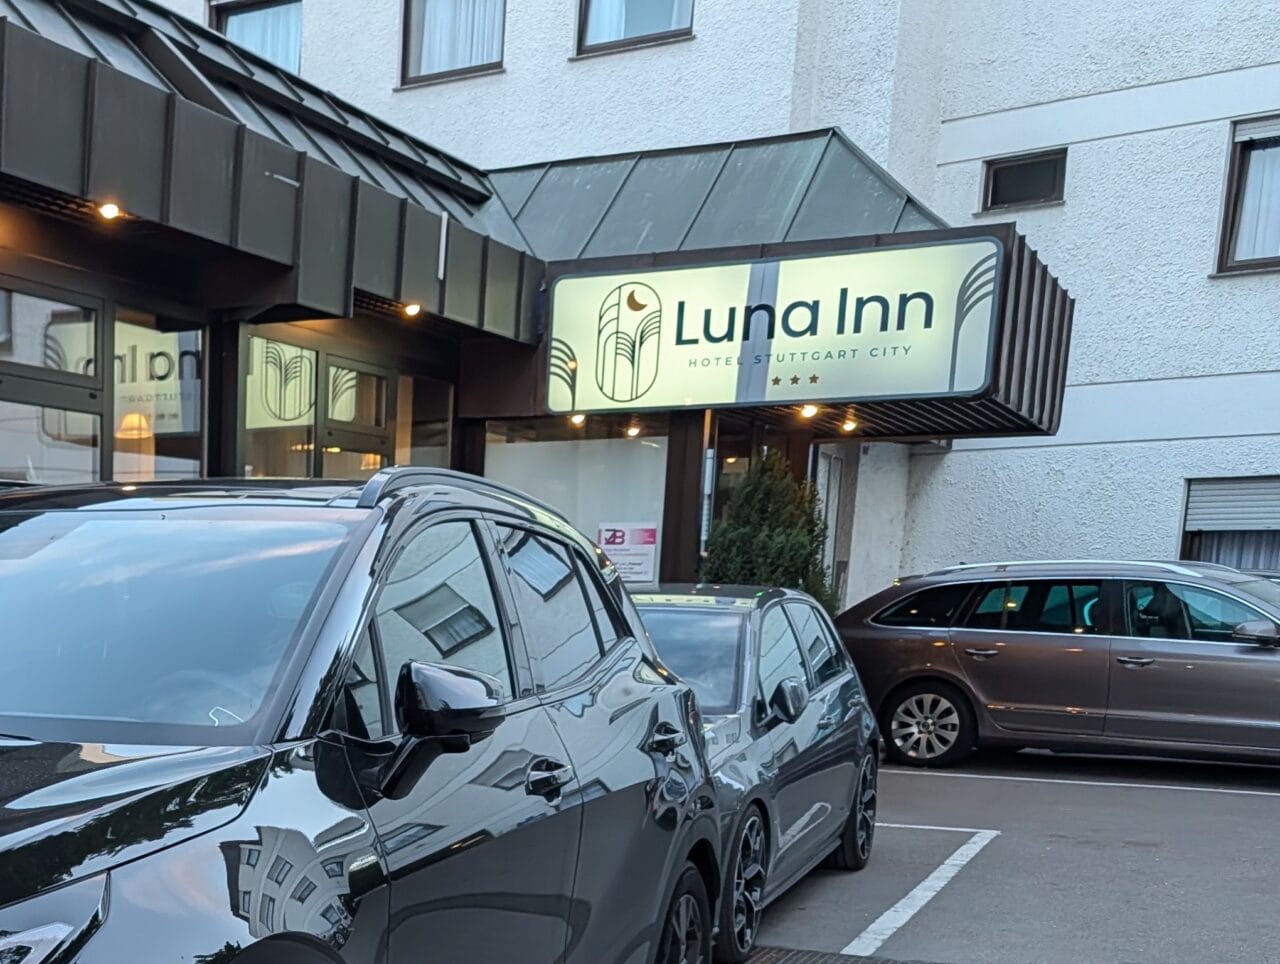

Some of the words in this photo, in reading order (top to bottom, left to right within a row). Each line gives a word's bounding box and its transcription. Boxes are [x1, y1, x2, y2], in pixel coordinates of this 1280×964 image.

[675, 300, 820, 346] Luna
[836, 287, 934, 335] Inn
[688, 355, 743, 368] HOTEL
[753, 348, 859, 365] STUTTGART
[869, 344, 912, 358] CITY
